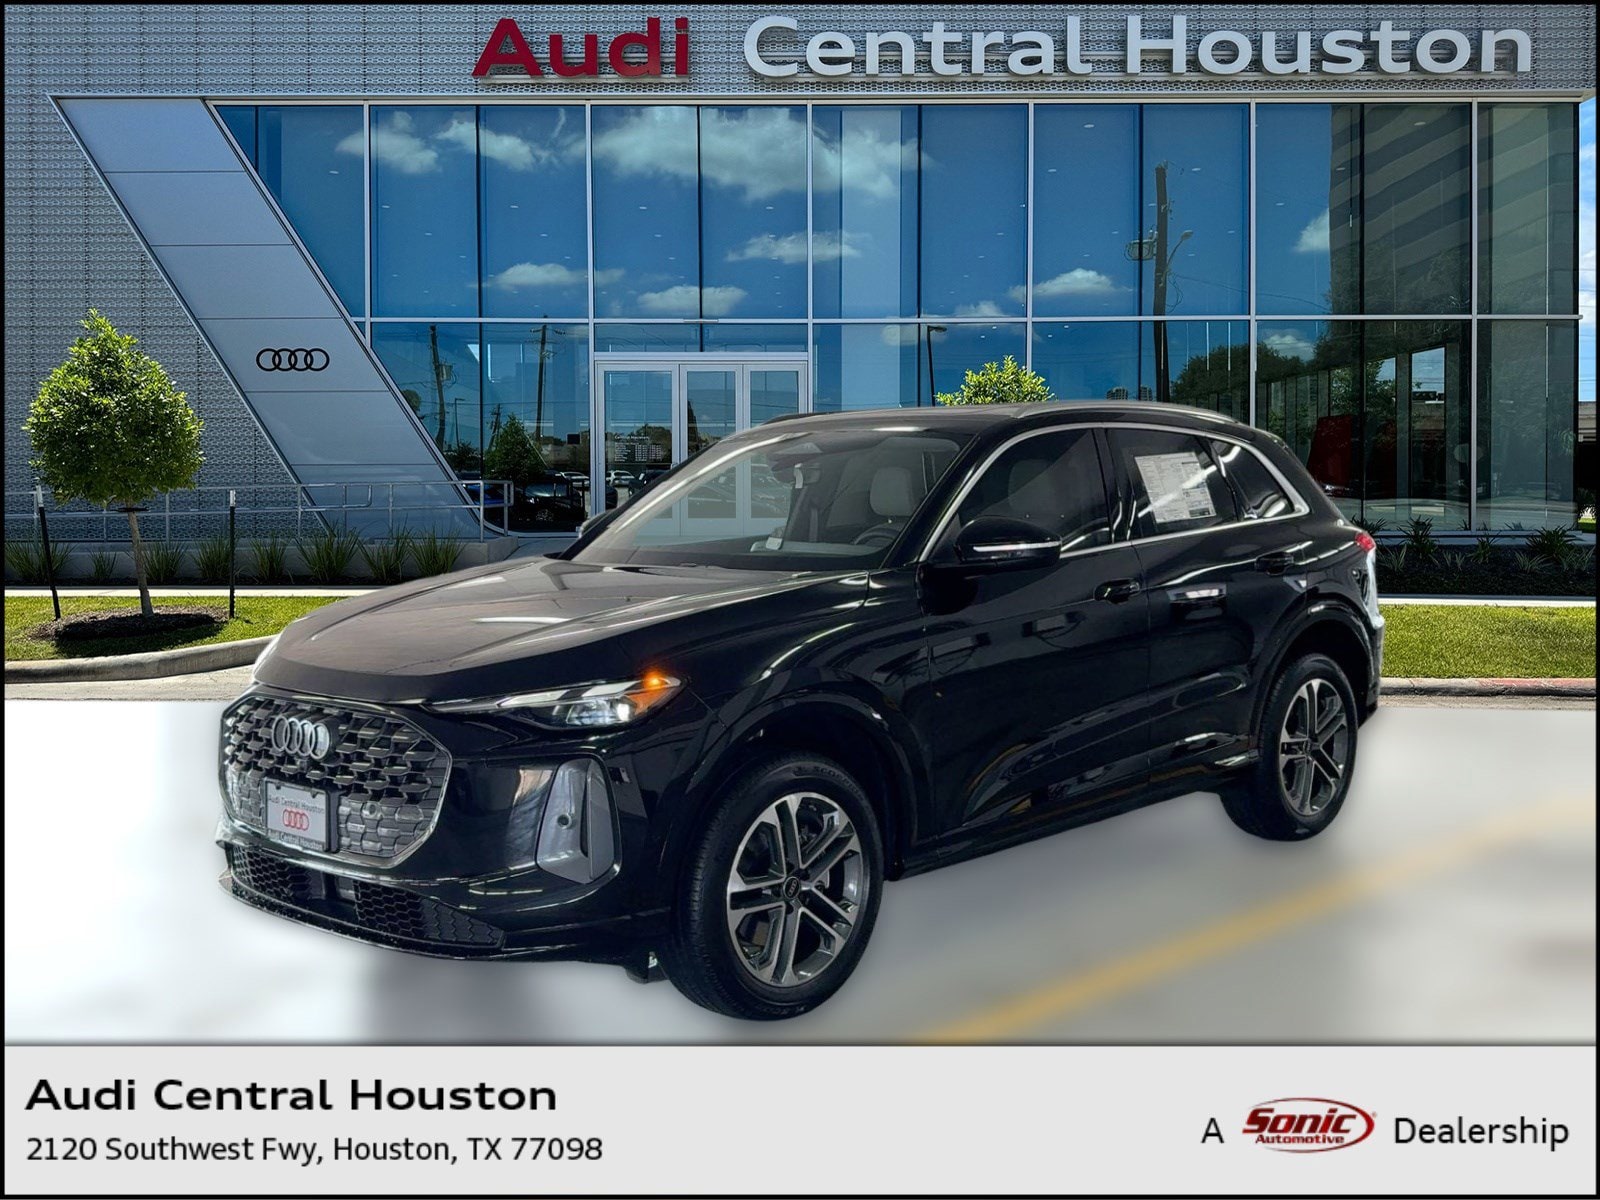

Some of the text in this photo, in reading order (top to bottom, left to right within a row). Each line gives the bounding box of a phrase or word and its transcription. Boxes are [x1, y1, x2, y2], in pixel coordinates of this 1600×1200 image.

[471, 15, 1533, 79] Audi Central Houston
[281, 797, 300, 808] Central
[301, 802, 325, 814] Houston
